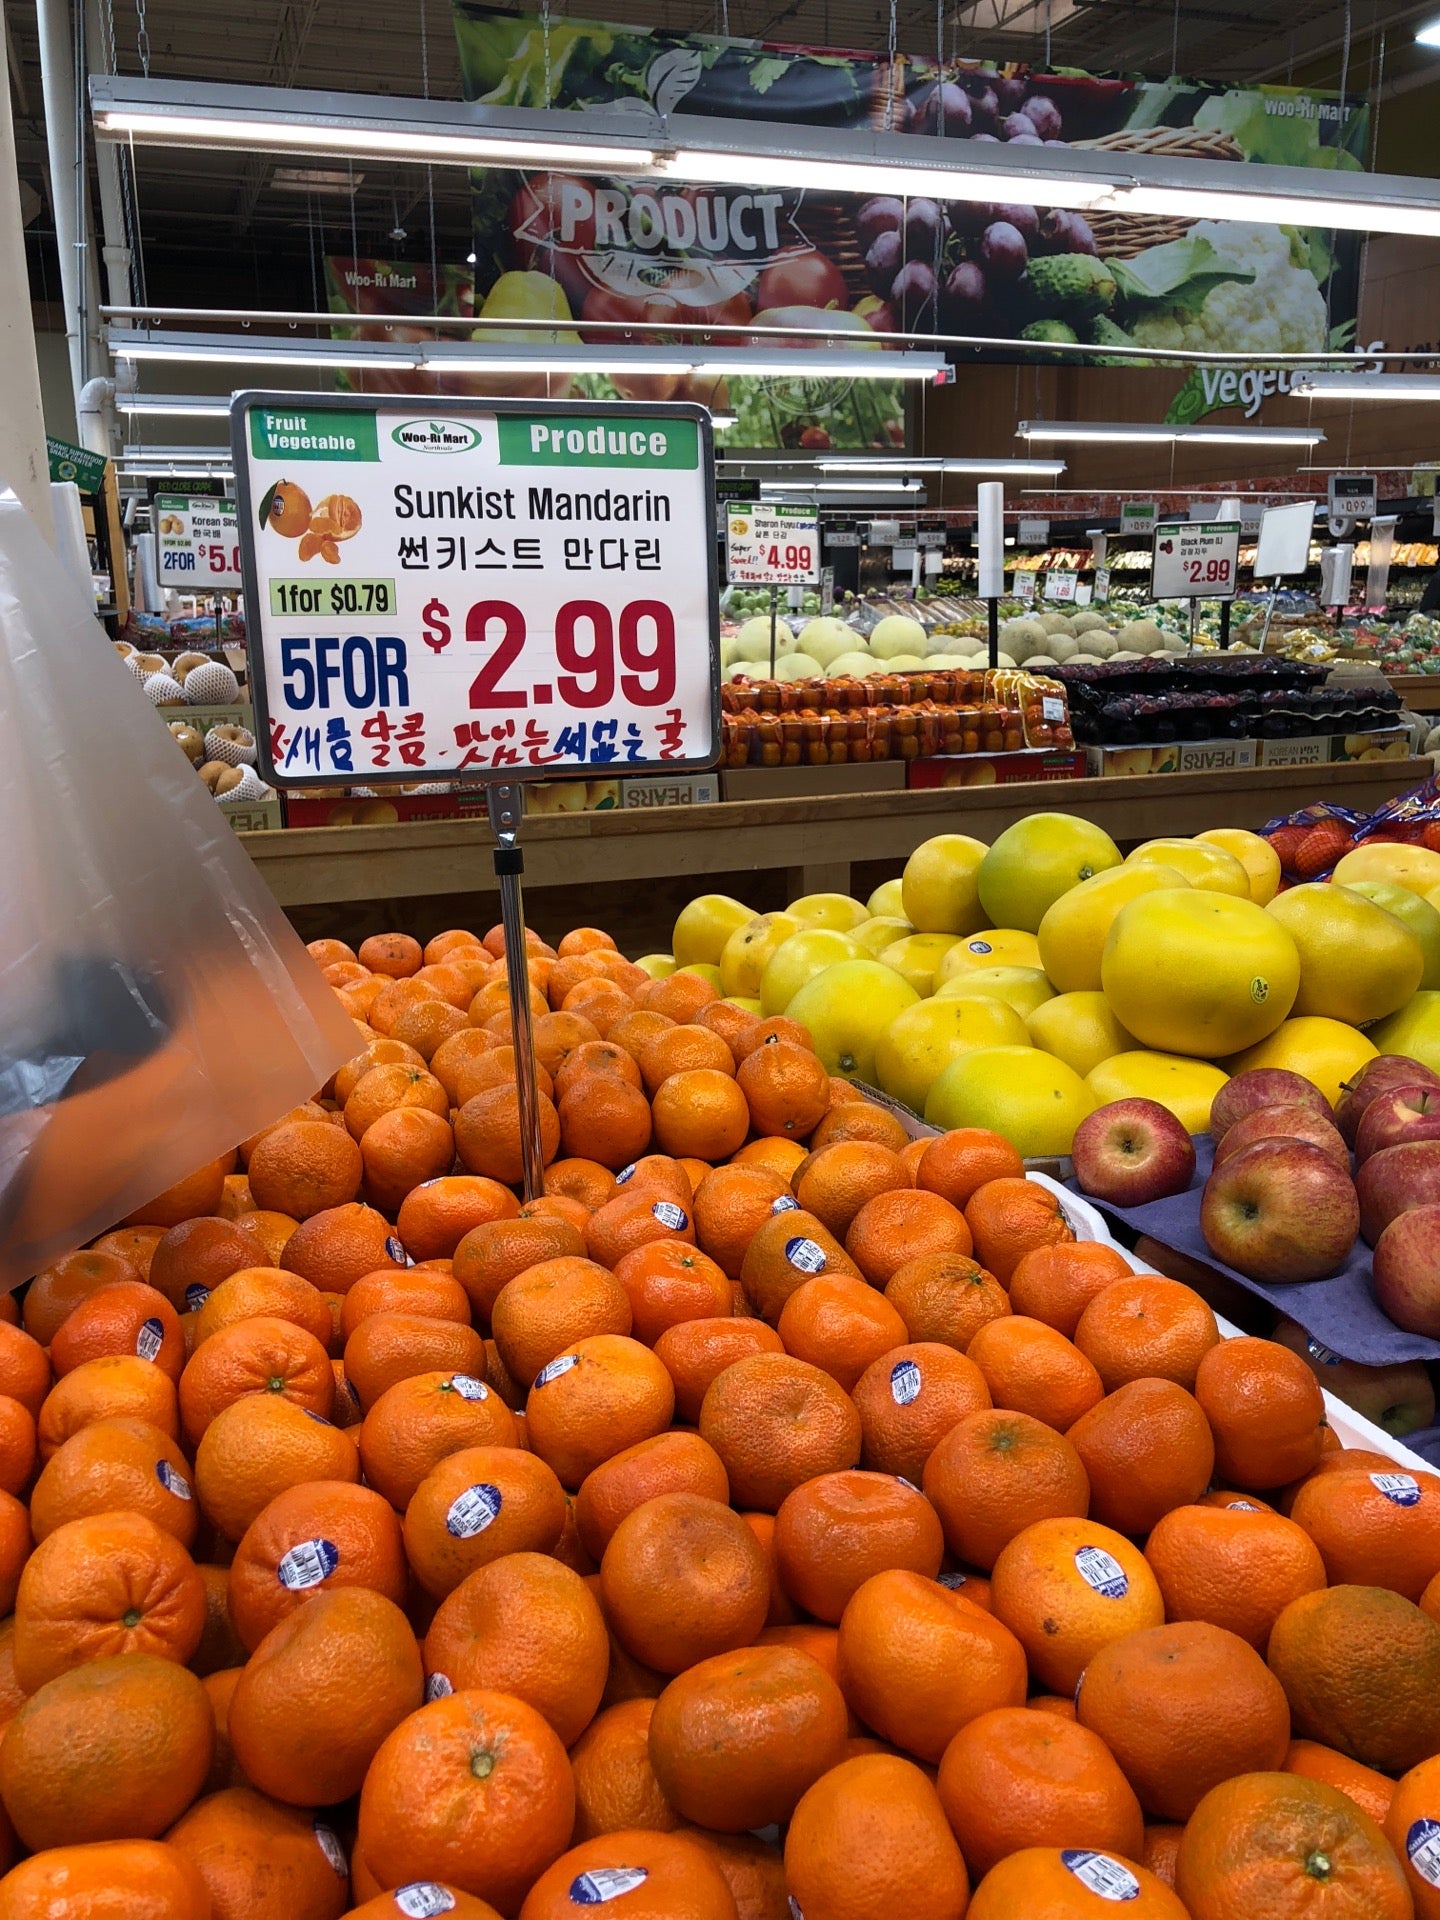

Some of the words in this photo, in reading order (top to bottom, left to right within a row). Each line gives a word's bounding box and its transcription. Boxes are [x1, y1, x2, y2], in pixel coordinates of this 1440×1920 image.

[560, 184, 784, 251] PRODUCT
[389, 272, 417, 289] Mart
[266, 415, 307, 431] Fruit
[267, 433, 356, 450] Vegetable
[401, 432, 441, 443] Woo-Ri
[443, 433, 468, 444] Mart
[529, 424, 668, 456] Produce
[394, 484, 516, 520] Sunkist
[528, 487, 672, 522] Mandarin
[781, 506, 812, 515] Produce
[192, 516, 221, 526] Korean
[754, 519, 779, 529] Sharon
[193, 529, 221, 539] 한국배
[1180, 537, 1198, 547] Black
[1199, 537, 1214, 546] Plum
[164, 551, 196, 571] 2FOR
[396, 536, 544, 570] 썬키스트
[564, 538, 662, 570] 만다린
[278, 584, 322, 610] 1for
[331, 584, 389, 613] $0.79
[281, 636, 410, 711] 5FOR
[360, 710, 427, 767] 달콤
[1184, 750, 1236, 770] PEARS
[627, 787, 692, 808] PEARS
[473, 1486, 500, 1516] Sunkist
[452, 1514, 469, 1533] 4055
